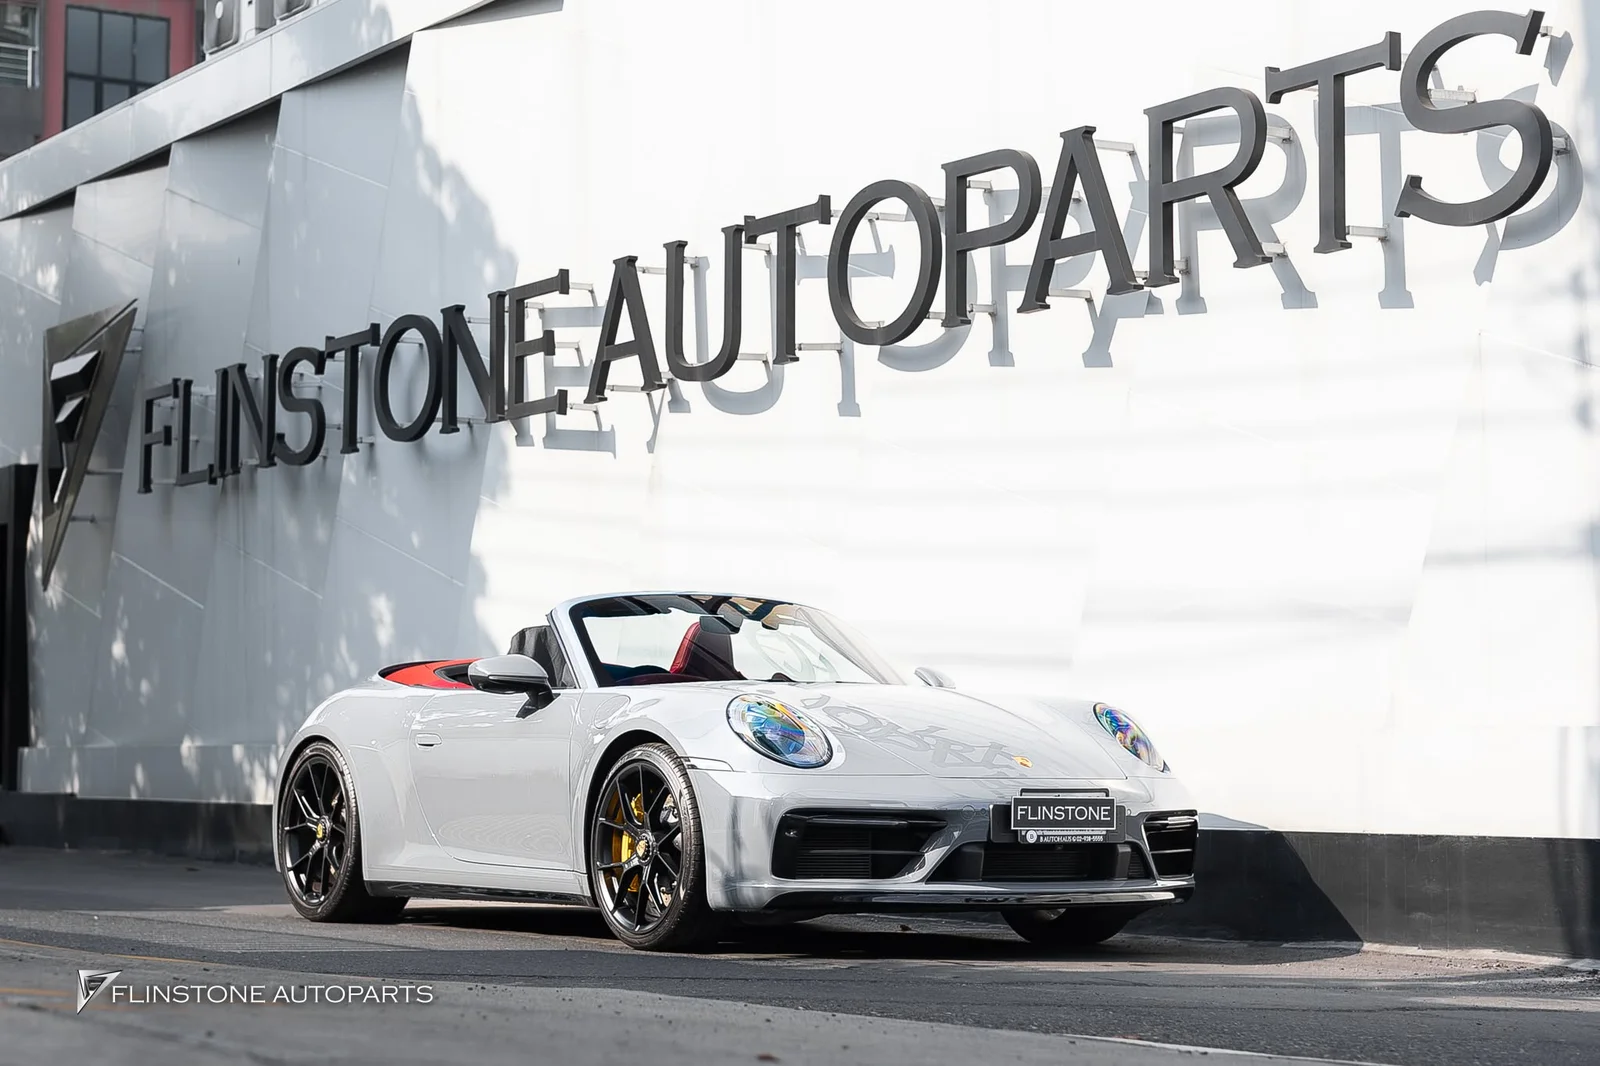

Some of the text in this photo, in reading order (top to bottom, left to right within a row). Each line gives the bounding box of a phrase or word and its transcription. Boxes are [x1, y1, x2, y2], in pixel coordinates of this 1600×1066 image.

[137, 9, 1553, 494] FLINSTONE AUTOPARTS
[1017, 806, 1111, 820] FLINSTONE
